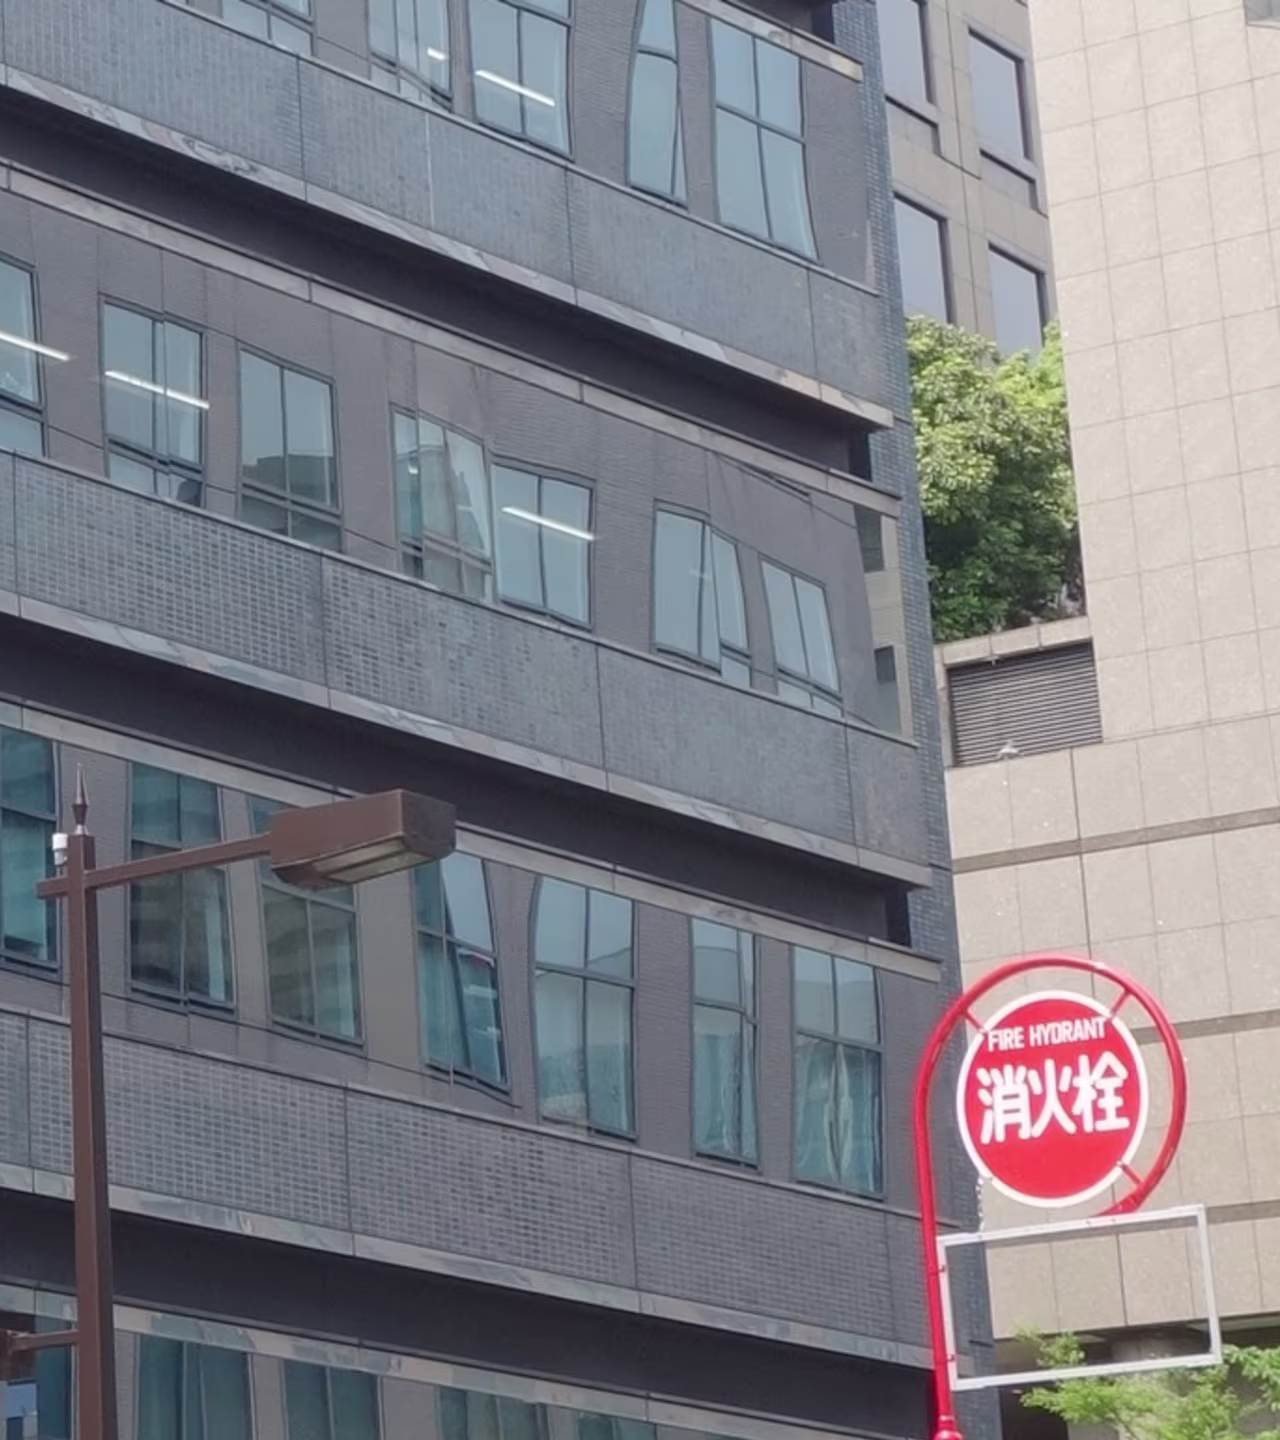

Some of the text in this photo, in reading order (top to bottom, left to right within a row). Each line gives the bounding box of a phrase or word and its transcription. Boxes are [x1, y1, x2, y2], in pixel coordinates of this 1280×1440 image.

[987, 1016, 1107, 1053] FIRE HYDRANT
[975, 1050, 1131, 1145] 消火栓
